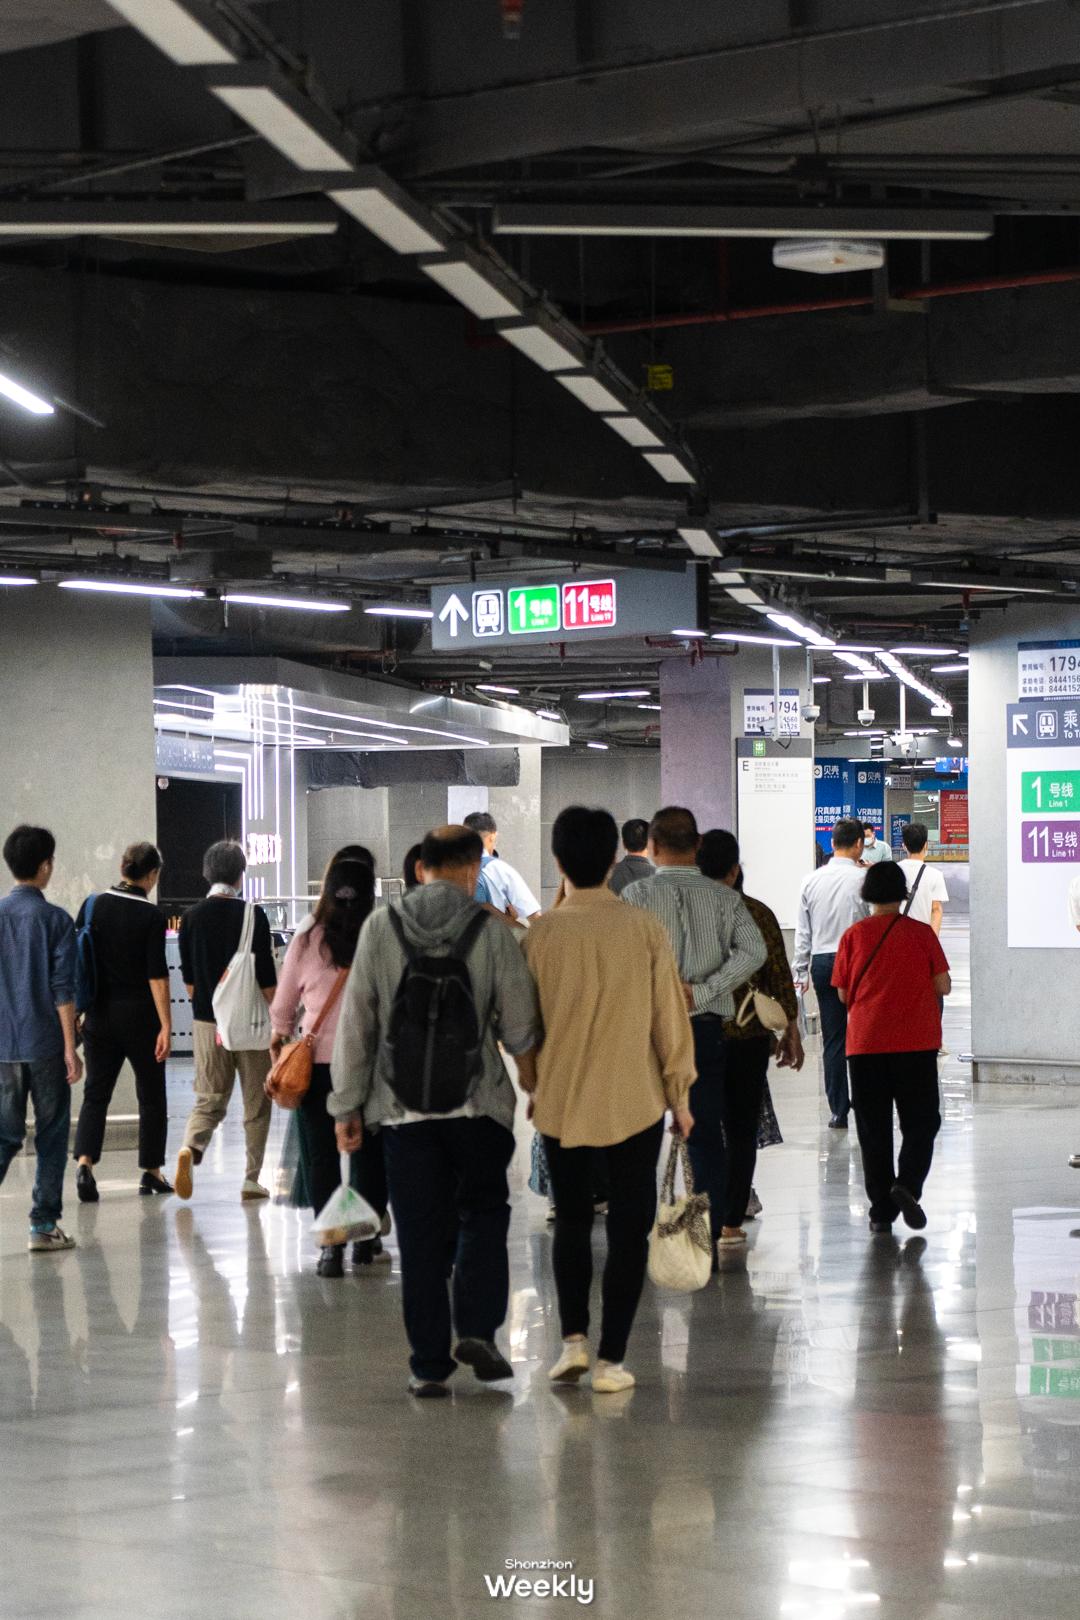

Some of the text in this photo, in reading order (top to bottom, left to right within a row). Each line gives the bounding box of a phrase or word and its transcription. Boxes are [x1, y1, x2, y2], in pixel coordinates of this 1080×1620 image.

[1063, 709, 1078, 729] 乘
[1063, 729, 1073, 739] To
[742, 760, 750, 771] E
[1048, 800, 1063, 808] Line
[1051, 850, 1067, 858] Line
